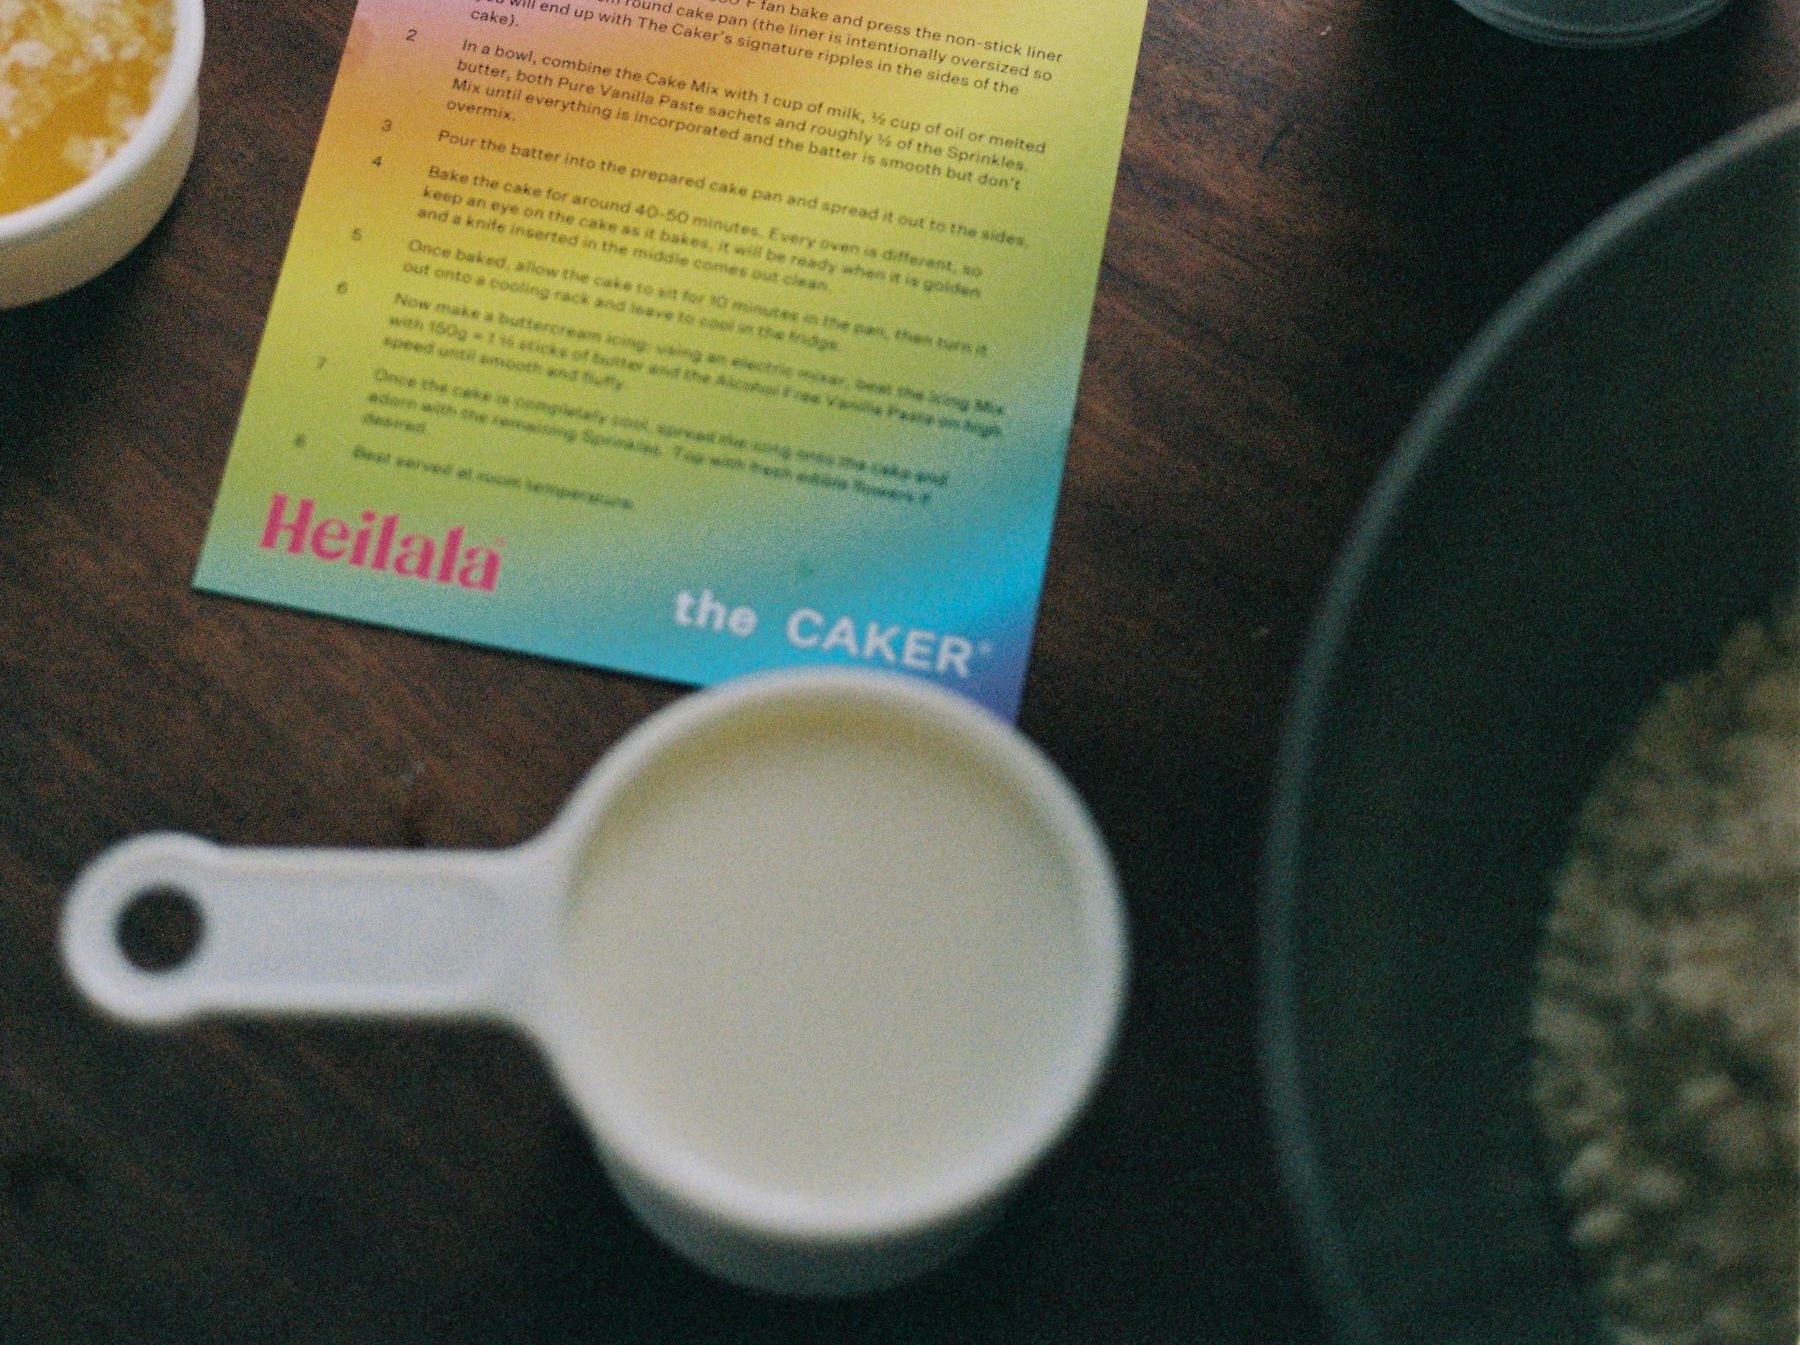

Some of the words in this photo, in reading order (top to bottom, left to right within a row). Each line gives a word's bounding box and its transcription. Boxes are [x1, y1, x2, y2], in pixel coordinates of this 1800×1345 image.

[405, 28, 418, 42] 2
[539, 2, 571, 16] end
[573, 9, 595, 21] up
[598, 13, 633, 27] with
[639, 16, 668, 33] The
[737, 37, 814, 59] signature
[817, 51, 873, 70] ripples
[877, 63, 892, 72] in
[896, 63, 923, 78] the
[927, 71, 969, 87] sides
[973, 78, 990, 90] of
[993, 81, 1020, 96] the
[675, 6, 714, 22] cake
[717, 14, 748, 27] pan
[752, 18, 785, 34] (the
[788, 23, 824, 41] liner
[828, 33, 842, 44] is
[846, 37, 947, 64] intentionally
[950, 55, 1030, 78] oversized
[1033, 69, 1053, 82] so
[789, 3, 829, 21] bake
[832, 14, 864, 28] and
[866, 20, 911, 36] press
[915, 27, 942, 41] the
[945, 33, 1021, 55] non-stick
[1026, 45, 1063, 62] liner
[451, 77, 480, 94] Mix
[485, 87, 522, 101] until
[524, 93, 613, 121] everything
[615, 110, 630, 121] is
[633, 112, 740, 141] incorporated
[742, 132, 775, 147] and
[777, 137, 805, 152] the
[808, 141, 858, 160] batter
[862, 154, 876, 166] is
[879, 157, 942, 176] smooth
[945, 166, 973, 183] but
[461, 38, 478, 52] In
[480, 45, 491, 56] a
[541, 56, 612, 76] combine
[615, 67, 642, 82] the
[645, 71, 687, 90] Cake
[690, 79, 719, 95] Mix
[724, 89, 758, 102] with
[763, 92, 770, 104] 1
[772, 96, 804, 111] cup
[806, 101, 824, 114] of
[889, 117, 921, 133] cup
[924, 122, 942, 134] of
[944, 127, 965, 139] oil
[967, 132, 985, 142] or
[988, 135, 1047, 155] melted
[516, 69, 554, 87] both
[557, 76, 595, 94] Pure
[600, 84, 655, 105] Vanilla
[658, 94, 704, 114] Paste
[708, 106, 771, 126] sachets
[775, 118, 807, 132] and
[810, 124, 873, 146] roughly
[896, 139, 913, 150] of
[916, 142, 943, 156] the
[260, 492, 502, 594] Heilala
[673, 588, 758, 639] the
